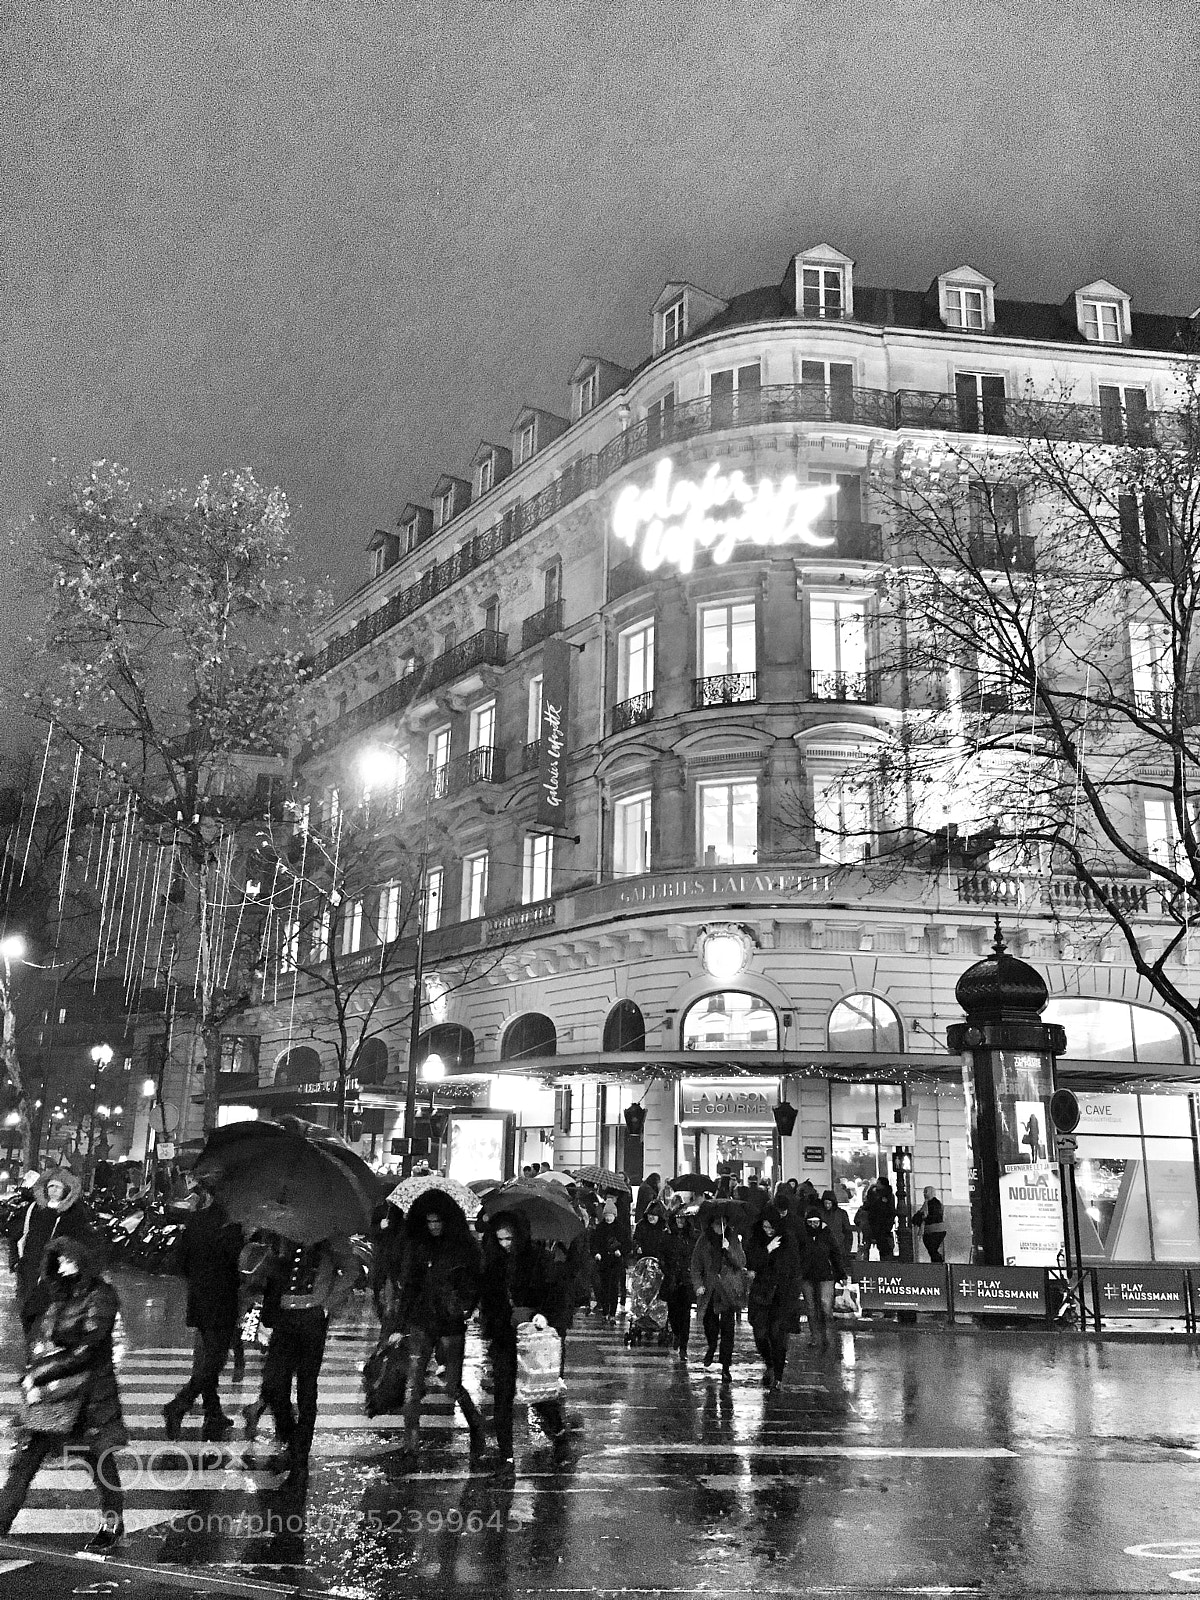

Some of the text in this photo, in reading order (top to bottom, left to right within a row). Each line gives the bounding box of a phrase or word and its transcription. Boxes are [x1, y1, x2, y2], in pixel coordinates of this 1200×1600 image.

[543, 761, 562, 806] Galeries
[620, 880, 705, 902] GALERIES
[692, 1091, 768, 1101] LA MAISON
[684, 1103, 700, 1114] LE
[1085, 1105, 1112, 1116] CAVE
[1024, 1175, 1048, 1187] LA
[1009, 1187, 1059, 1202] NOUVELLE
[878, 1277, 902, 1286] PLAY
[977, 1280, 1001, 1289] PLAY
[878, 1286, 941, 1295] HAUSSMANN
[1121, 1283, 1143, 1291] PLAY
[977, 1289, 1039, 1299] HAUSSMANN
[1122, 1292, 1180, 1300] HAUSSMANN
